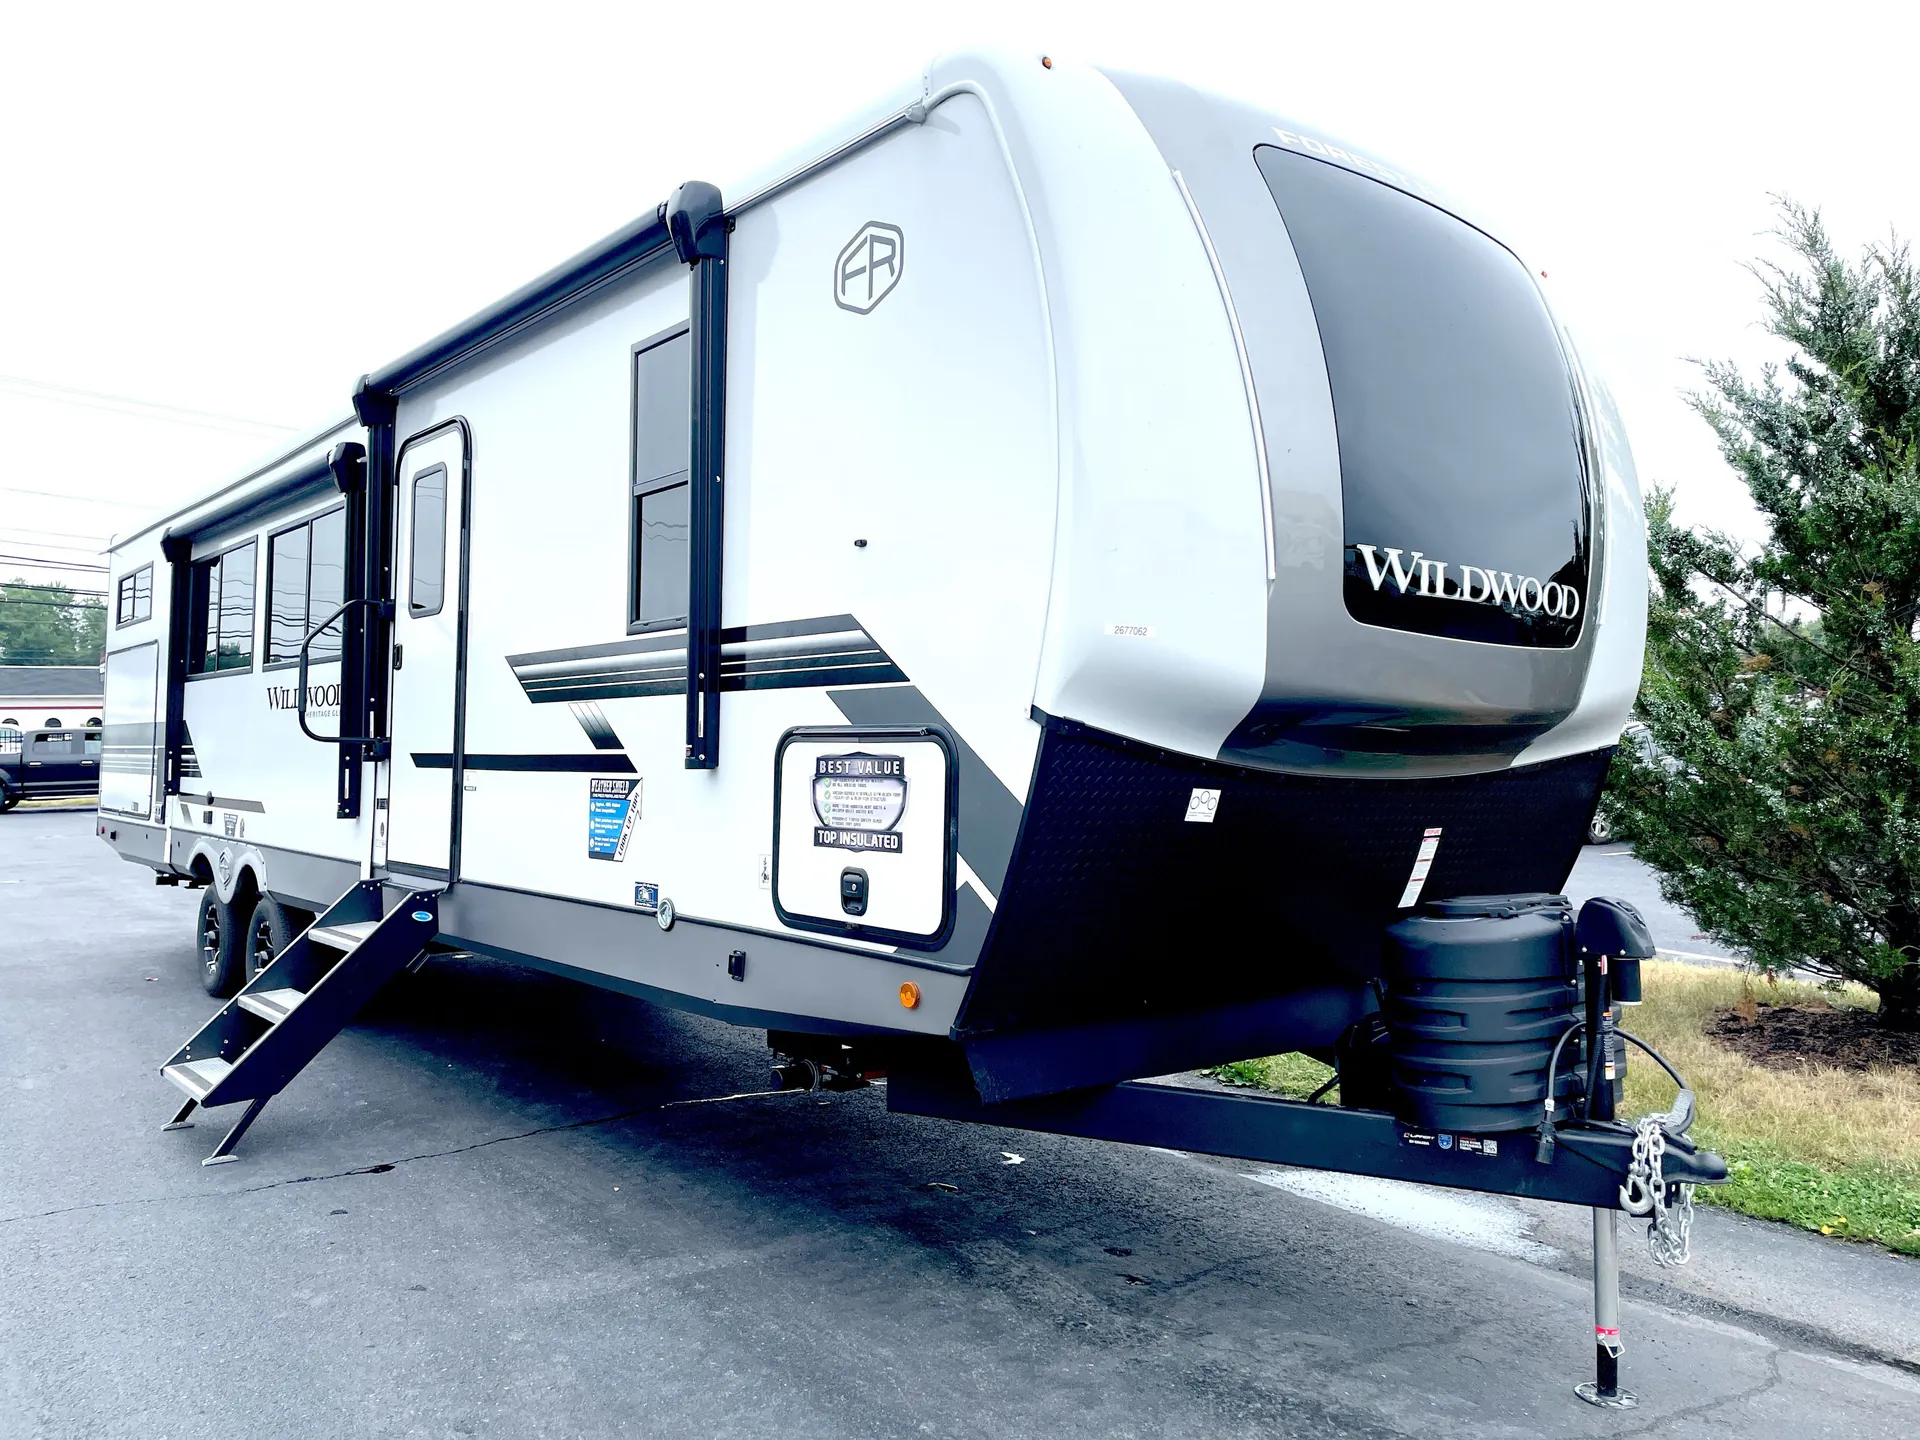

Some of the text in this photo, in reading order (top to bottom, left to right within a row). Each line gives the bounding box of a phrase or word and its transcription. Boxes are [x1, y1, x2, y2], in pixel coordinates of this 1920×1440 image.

[1270, 126, 1411, 187] FOREST
[1357, 543, 1580, 620] WILDWOOD
[1114, 625, 1148, 636] 2677062
[267, 683, 341, 710] WILWOO
[306, 710, 331, 718] HERITAGE
[820, 760, 900, 775] BEST VALUE
[818, 830, 898, 849] TOP INSULATED
